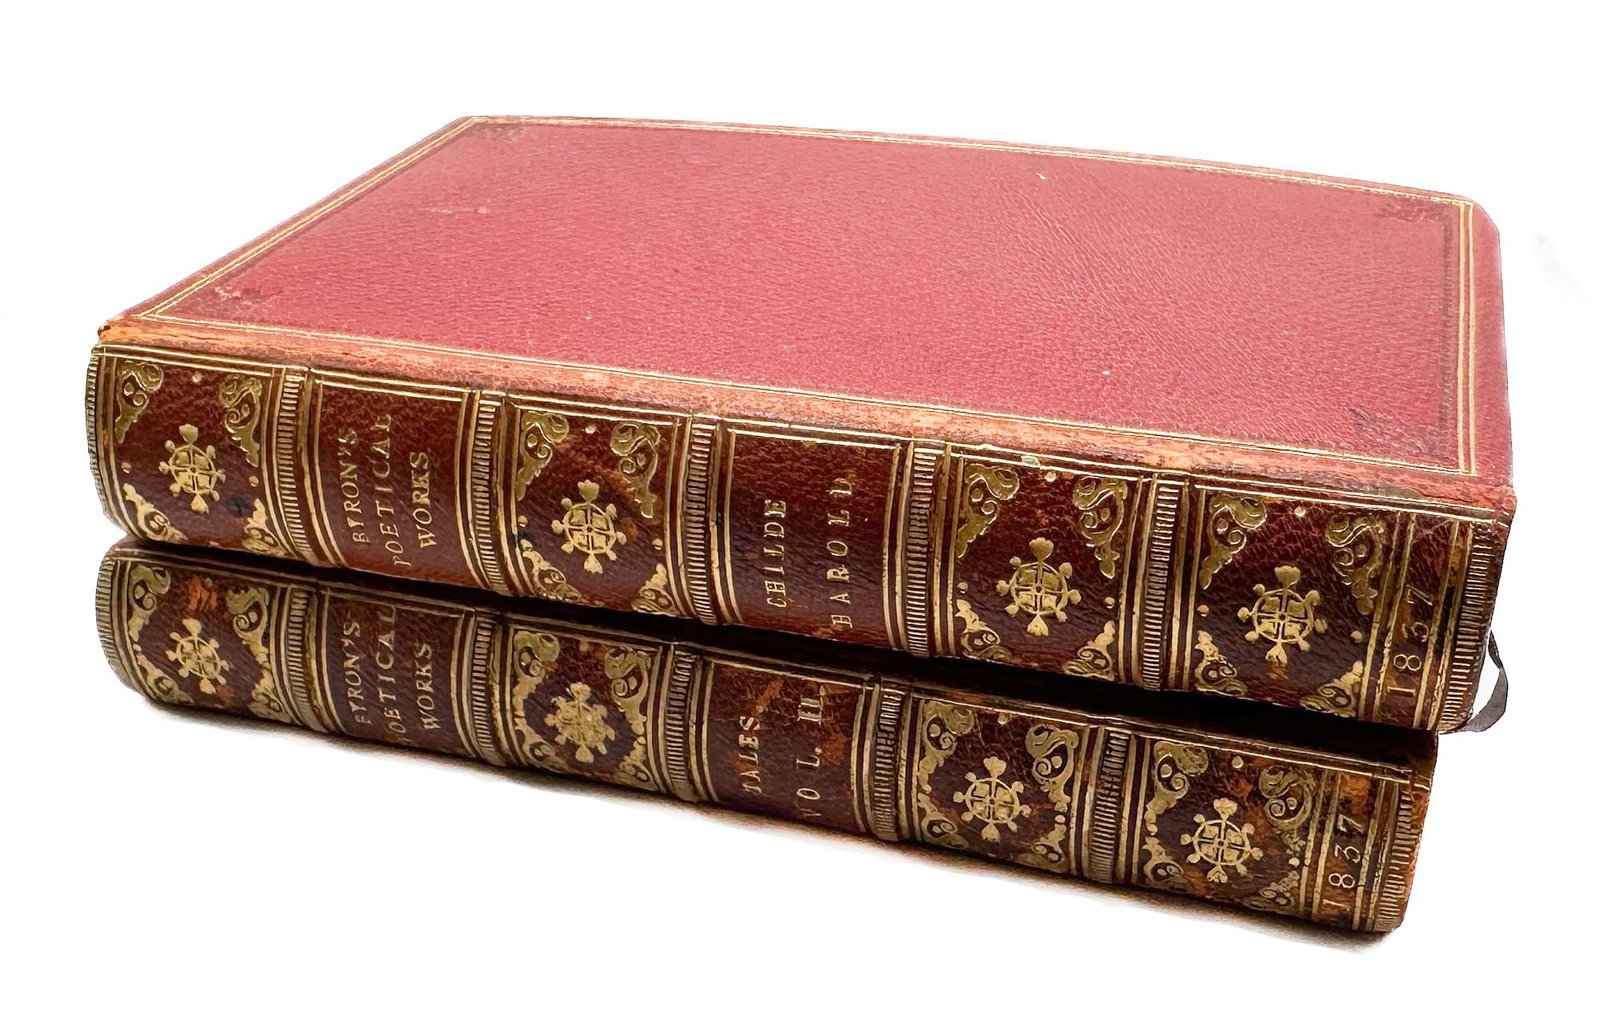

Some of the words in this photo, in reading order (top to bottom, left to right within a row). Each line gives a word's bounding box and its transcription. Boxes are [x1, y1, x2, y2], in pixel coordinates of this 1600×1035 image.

[338, 427, 371, 544] BYRON'S
[369, 414, 411, 566] POETICAL
[410, 452, 437, 548] WORKS
[763, 500, 787, 607] CHILDE
[826, 478, 854, 628] HAROLD
[415, 643, 441, 730] WORKS
[1387, 584, 1434, 696] 1837
[796, 747, 822, 817] VOL.
[1322, 814, 1364, 911] 1837
